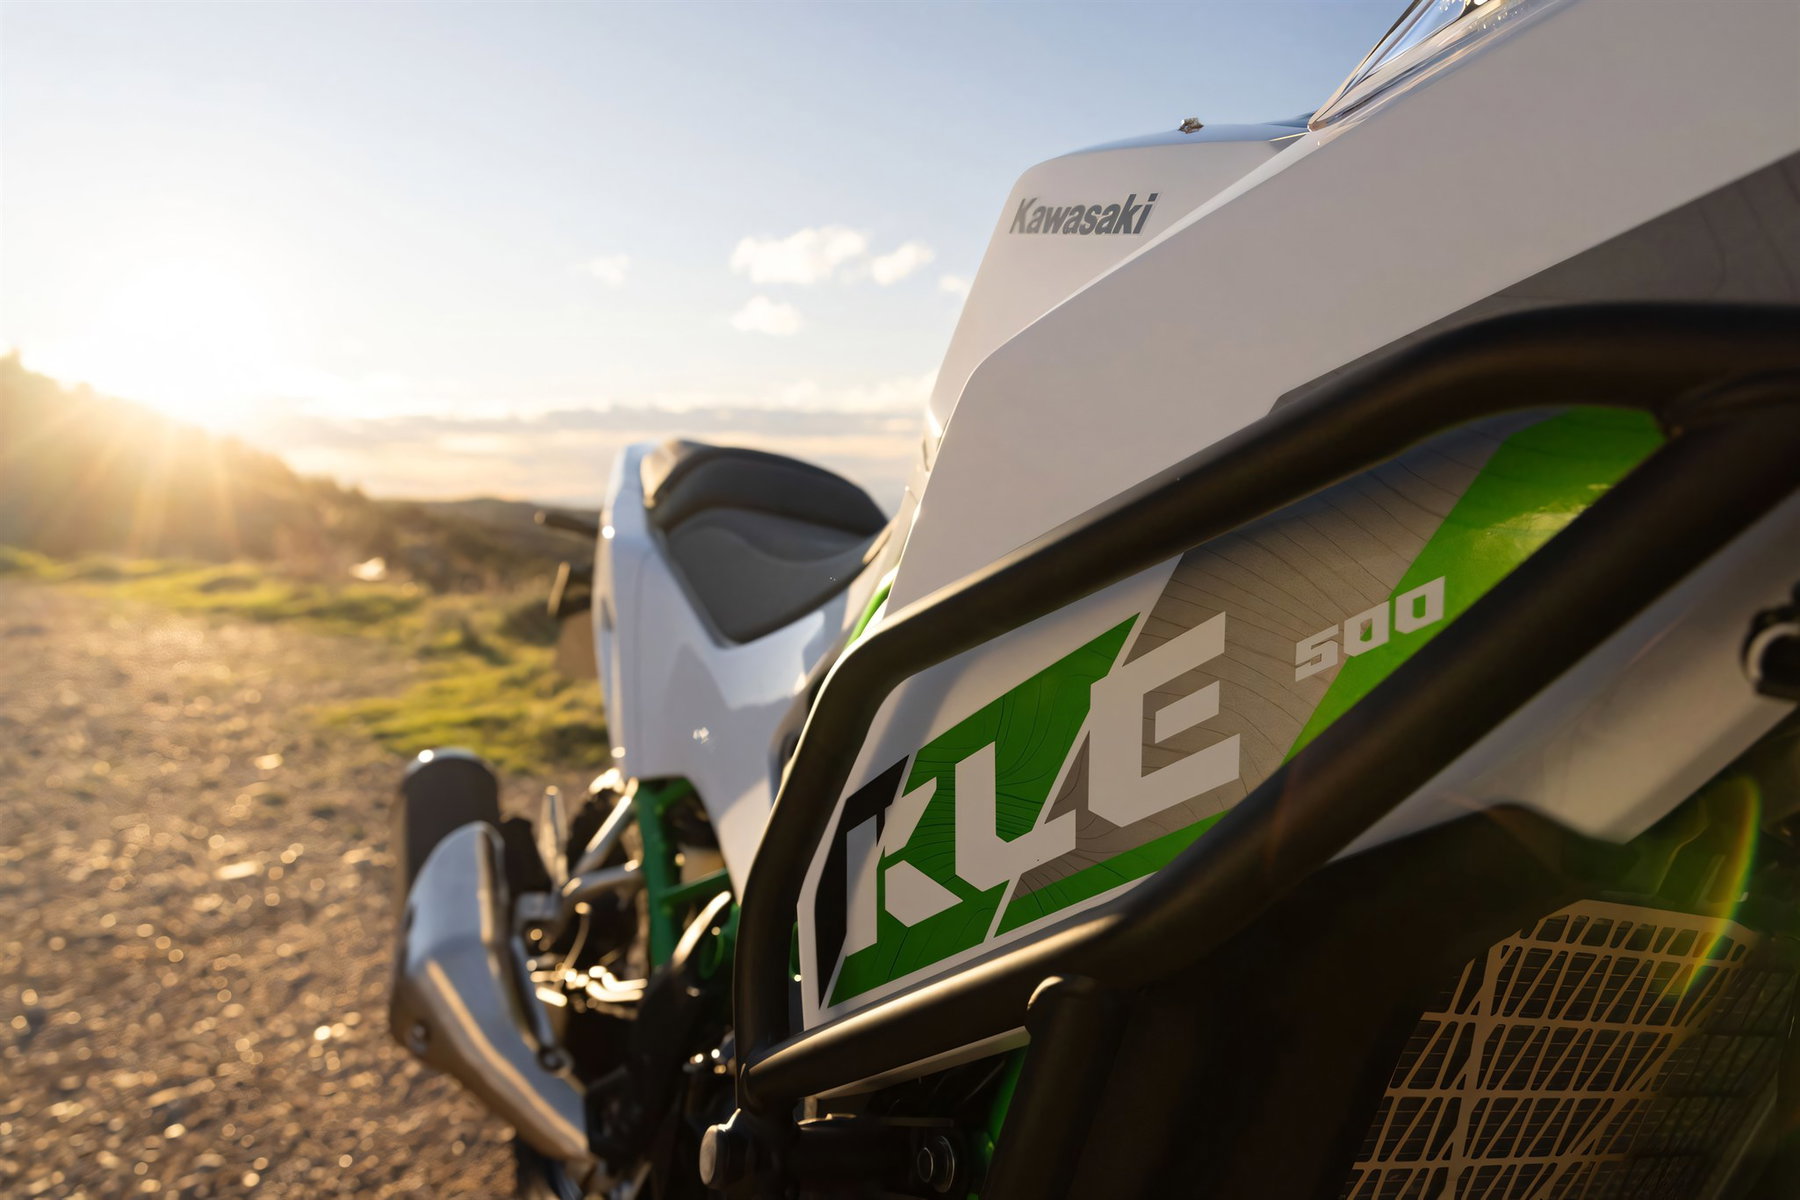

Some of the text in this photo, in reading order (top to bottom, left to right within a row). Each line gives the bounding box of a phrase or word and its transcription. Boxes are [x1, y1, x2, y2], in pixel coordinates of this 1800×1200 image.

[1009, 193, 1159, 235] Kawasaki
[846, 576, 1445, 957] KLE 500
